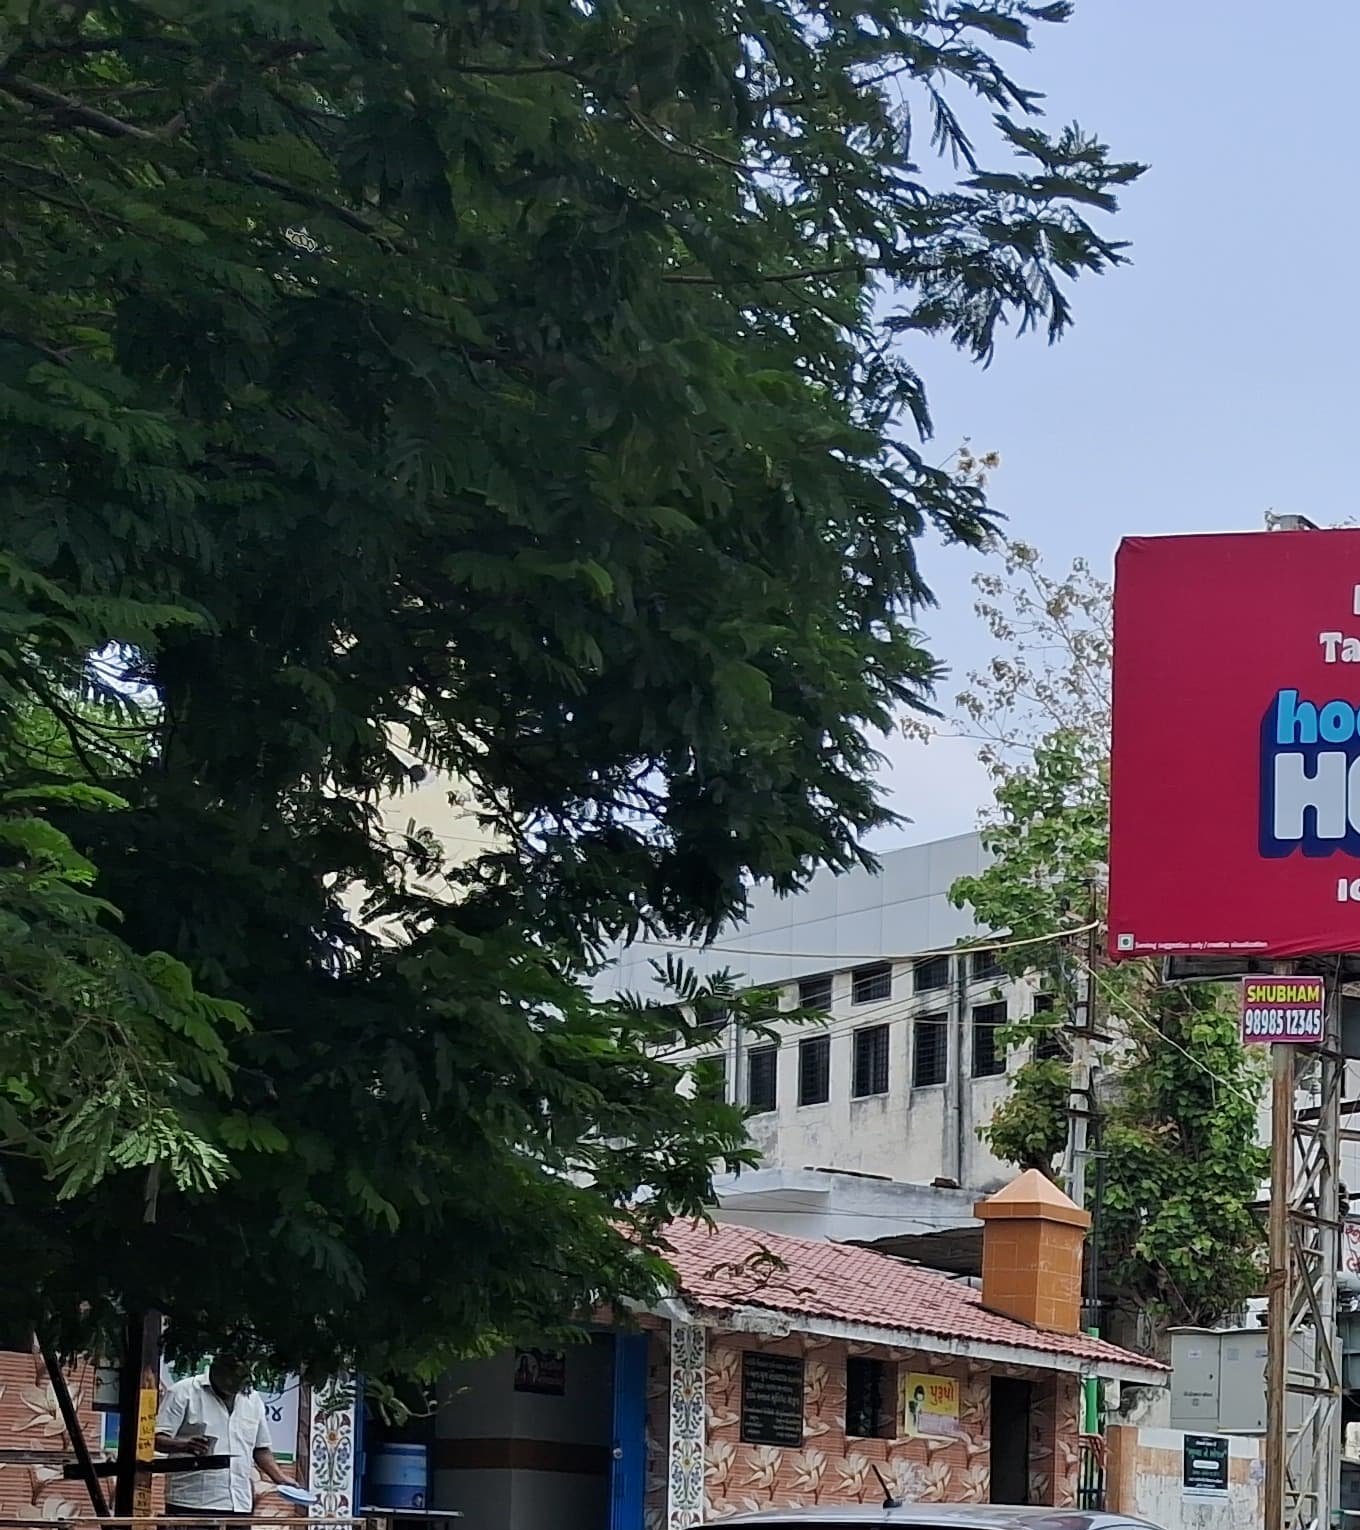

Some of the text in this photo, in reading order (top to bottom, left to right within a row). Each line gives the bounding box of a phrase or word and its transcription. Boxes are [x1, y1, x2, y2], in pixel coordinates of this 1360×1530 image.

[1247, 985, 1319, 1002] SHUBHAM
[1245, 1008, 1321, 1035] 98985 12345
